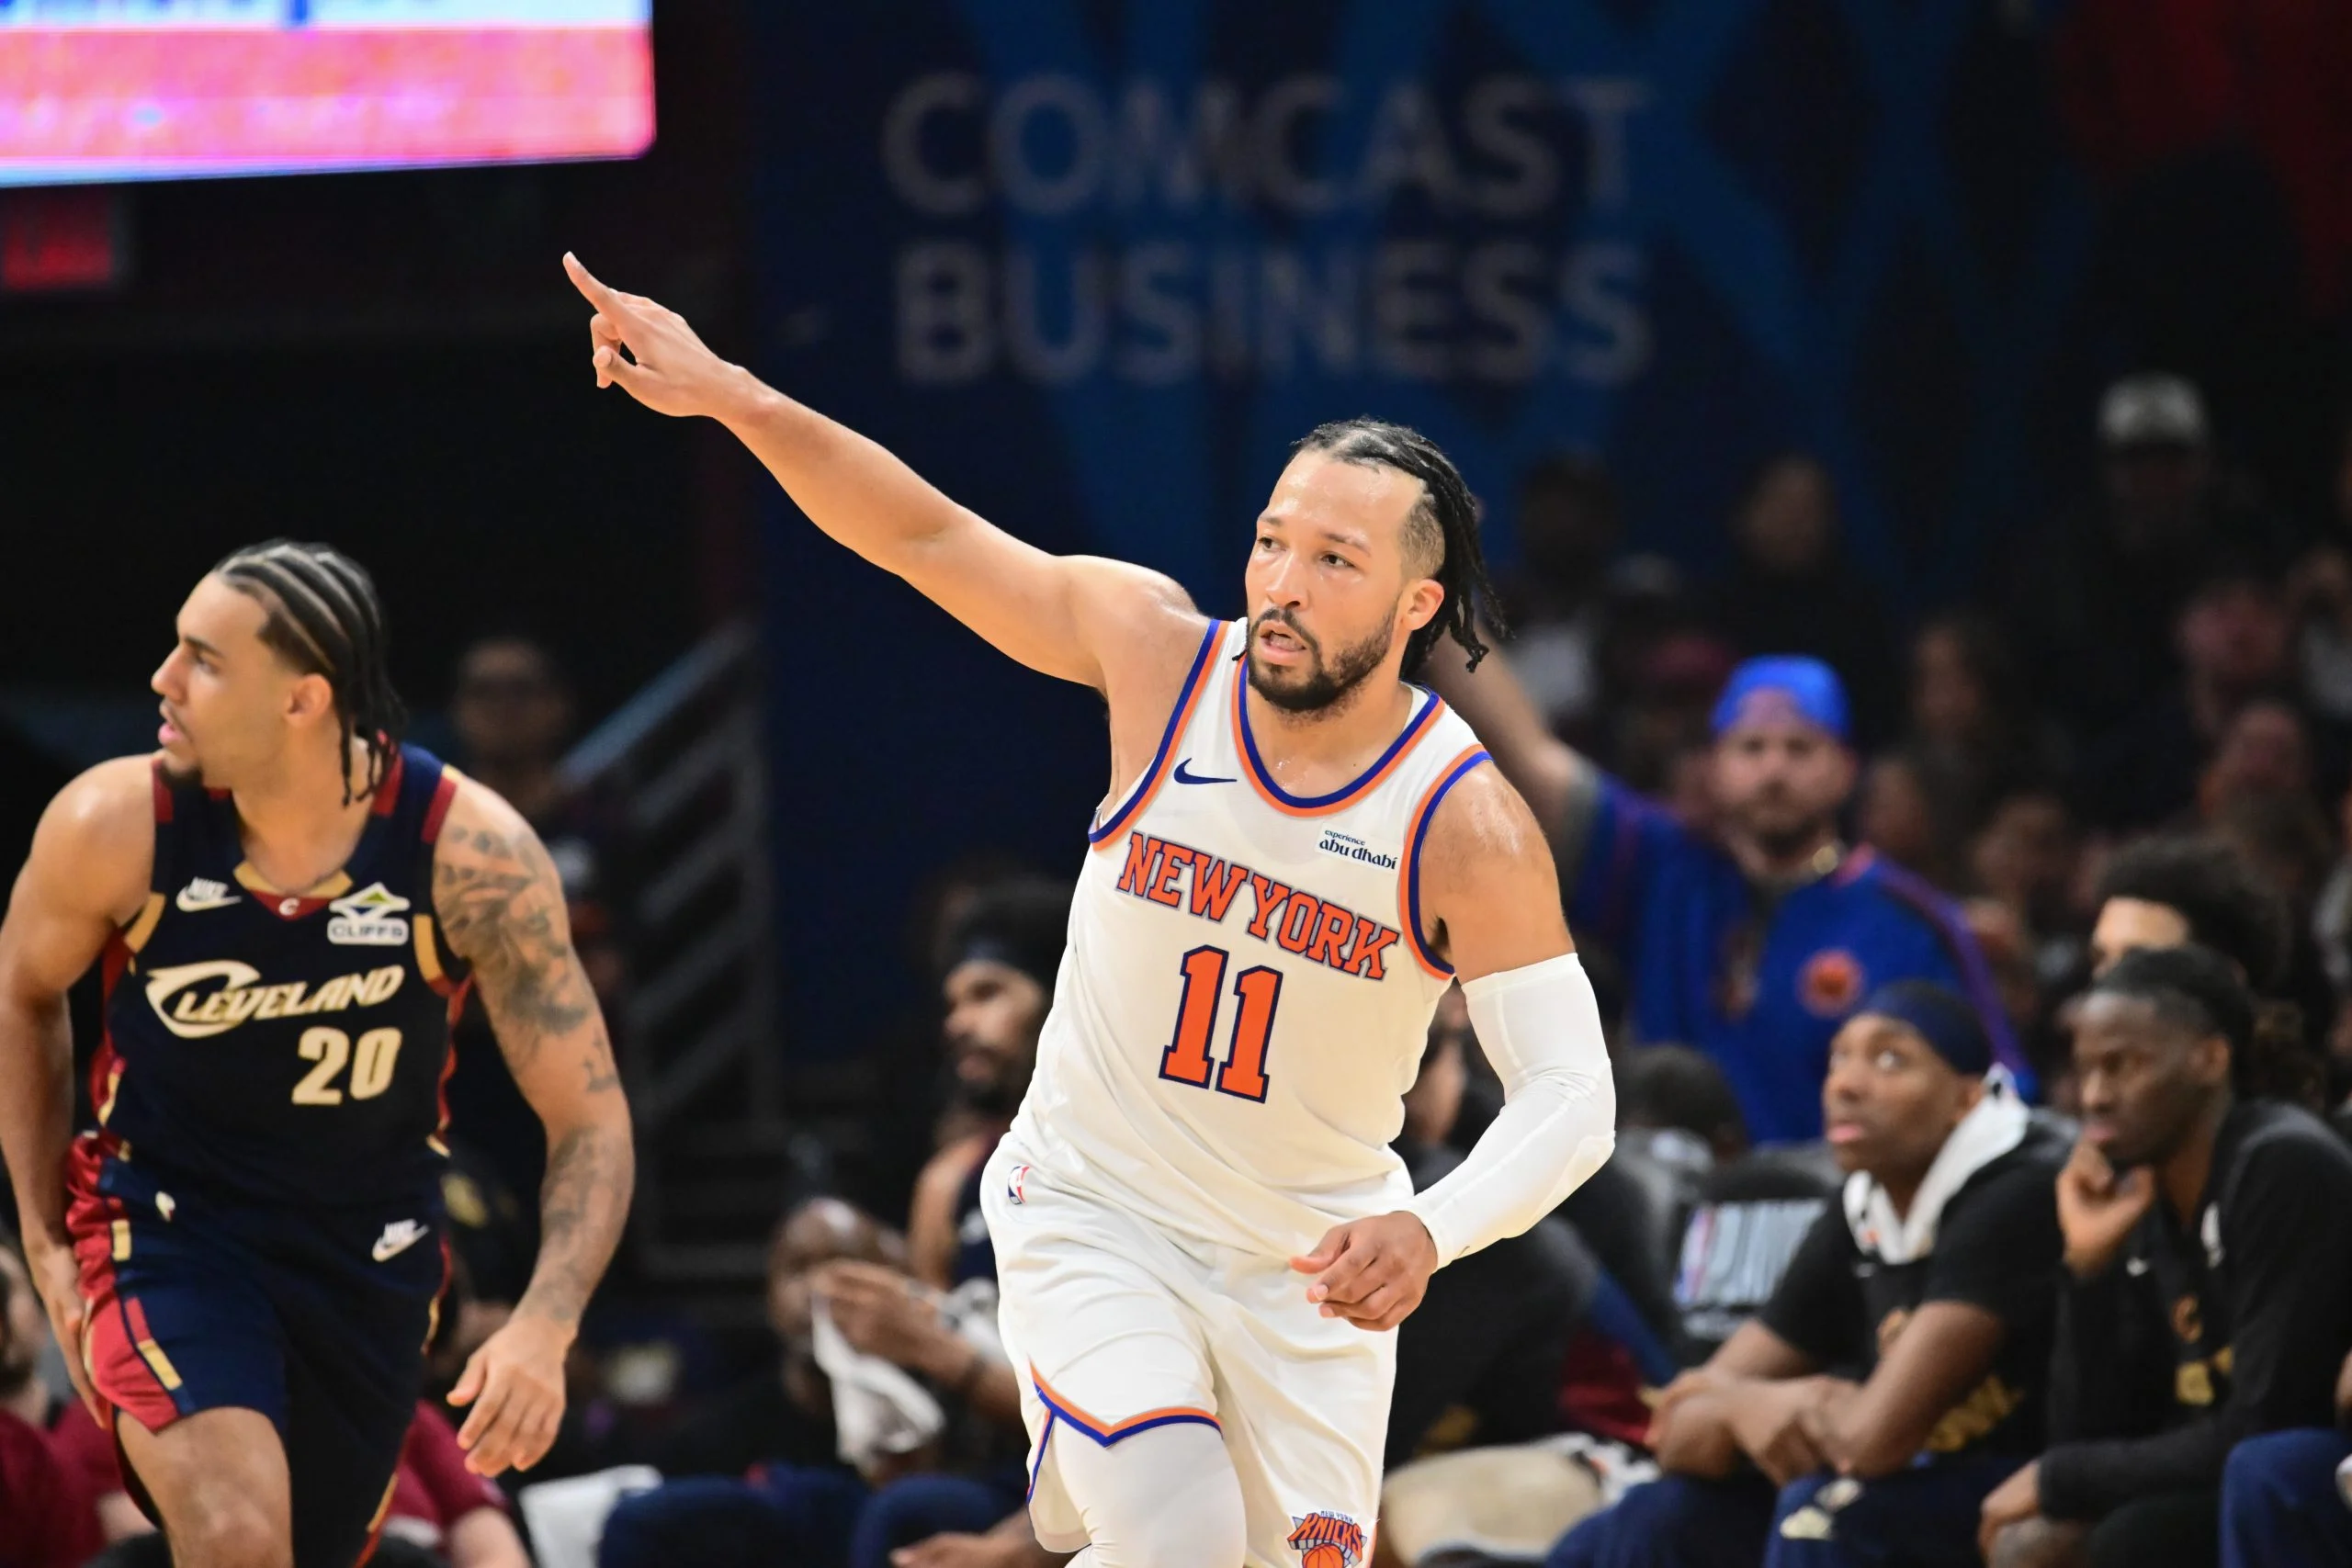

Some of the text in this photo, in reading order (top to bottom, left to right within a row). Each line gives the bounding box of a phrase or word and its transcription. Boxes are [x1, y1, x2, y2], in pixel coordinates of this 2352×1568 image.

[880, 72, 1651, 215] COMCAST
[895, 239, 1654, 386] BUSINESS
[1319, 839, 1397, 870] abu dhabi
[1325, 829, 1365, 846] experience
[332, 924, 404, 938] CLIFFS
[1116, 830, 1404, 982] NEW YORK
[145, 960, 405, 1038] CLEVELAND
[1159, 944, 1283, 1104] 11
[291, 1026, 402, 1105] 20
[1287, 1512, 1363, 1562] KNICKS
